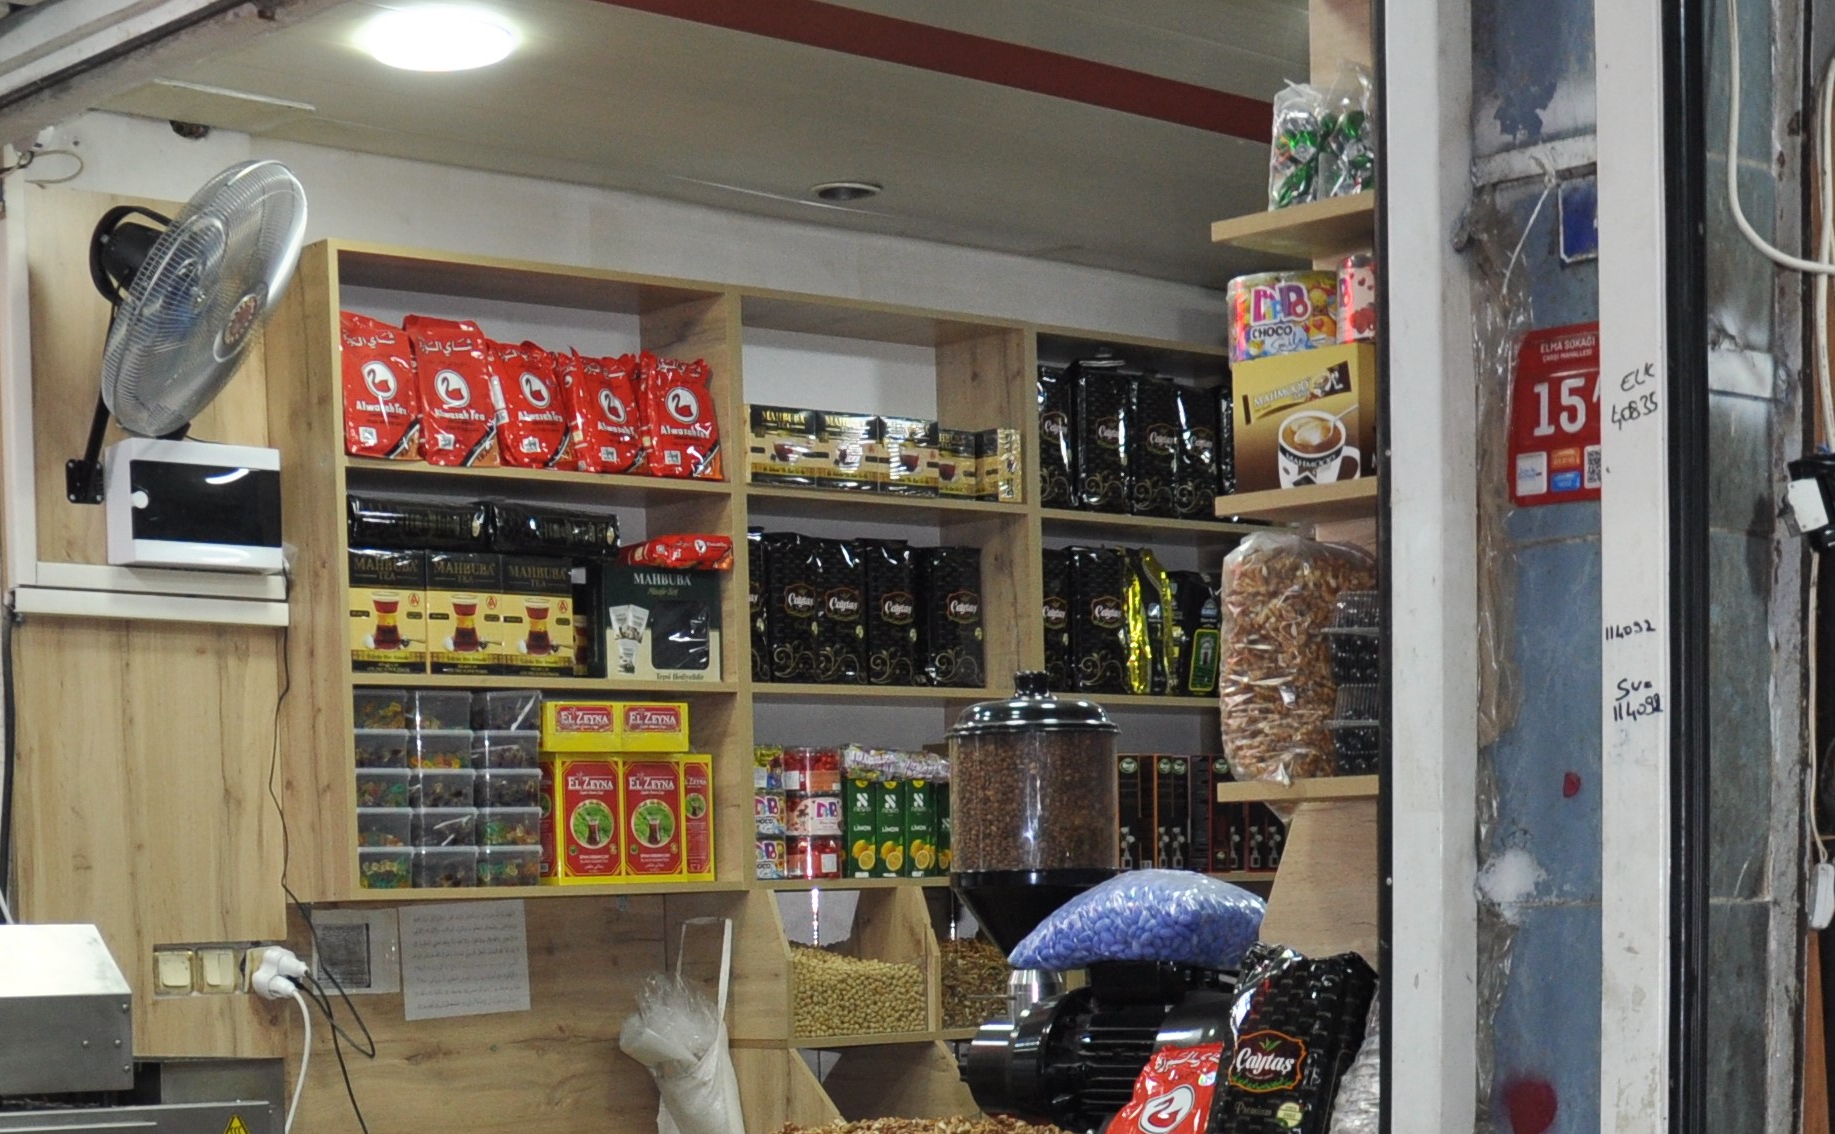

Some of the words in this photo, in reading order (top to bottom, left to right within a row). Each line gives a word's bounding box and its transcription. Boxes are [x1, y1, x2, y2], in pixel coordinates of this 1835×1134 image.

[1252, 325, 1293, 339] CHOCO
[1540, 341, 1563, 353] ELMA
[1564, 335, 1595, 350] SOKAĞI
[1621, 362, 1656, 392] ELK
[1253, 377, 1310, 407] MAHMOOD
[434, 561, 495, 576] MAHBUBA
[633, 572, 692, 586] MAHBUBA
[561, 711, 573, 724] EL
[576, 711, 609, 725] ZEYNA
[629, 711, 642, 724] EL
[644, 711, 676, 725] ZEYNA
[568, 776, 581, 790] EL
[583, 777, 614, 790] ZEYNA
[629, 776, 642, 790] EL
[644, 777, 675, 790] ZEYNA
[1236, 1047, 1295, 1075] Çaytaş
